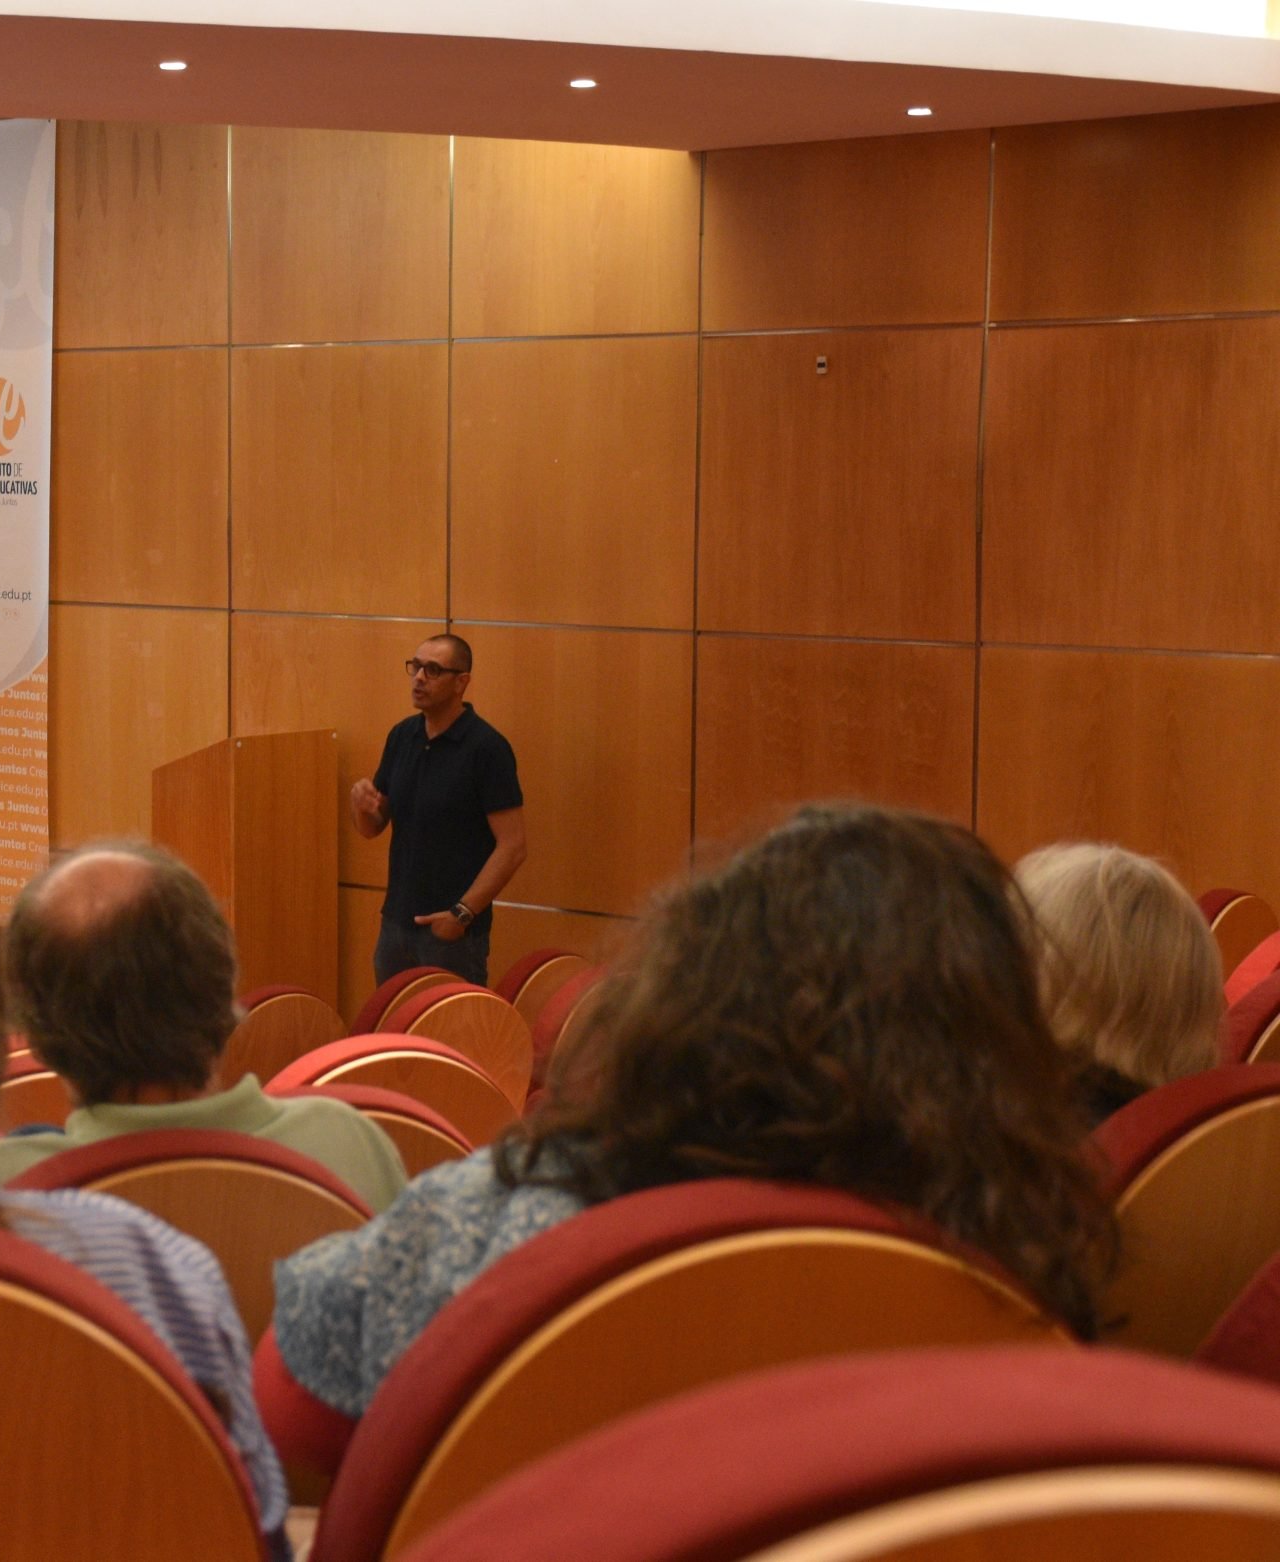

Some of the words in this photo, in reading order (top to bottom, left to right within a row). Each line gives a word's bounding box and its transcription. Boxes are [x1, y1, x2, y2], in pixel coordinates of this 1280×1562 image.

[13, 463, 23, 478] DE
[7, 688, 40, 701] Juntos
[7, 800, 40, 816] Juntos
